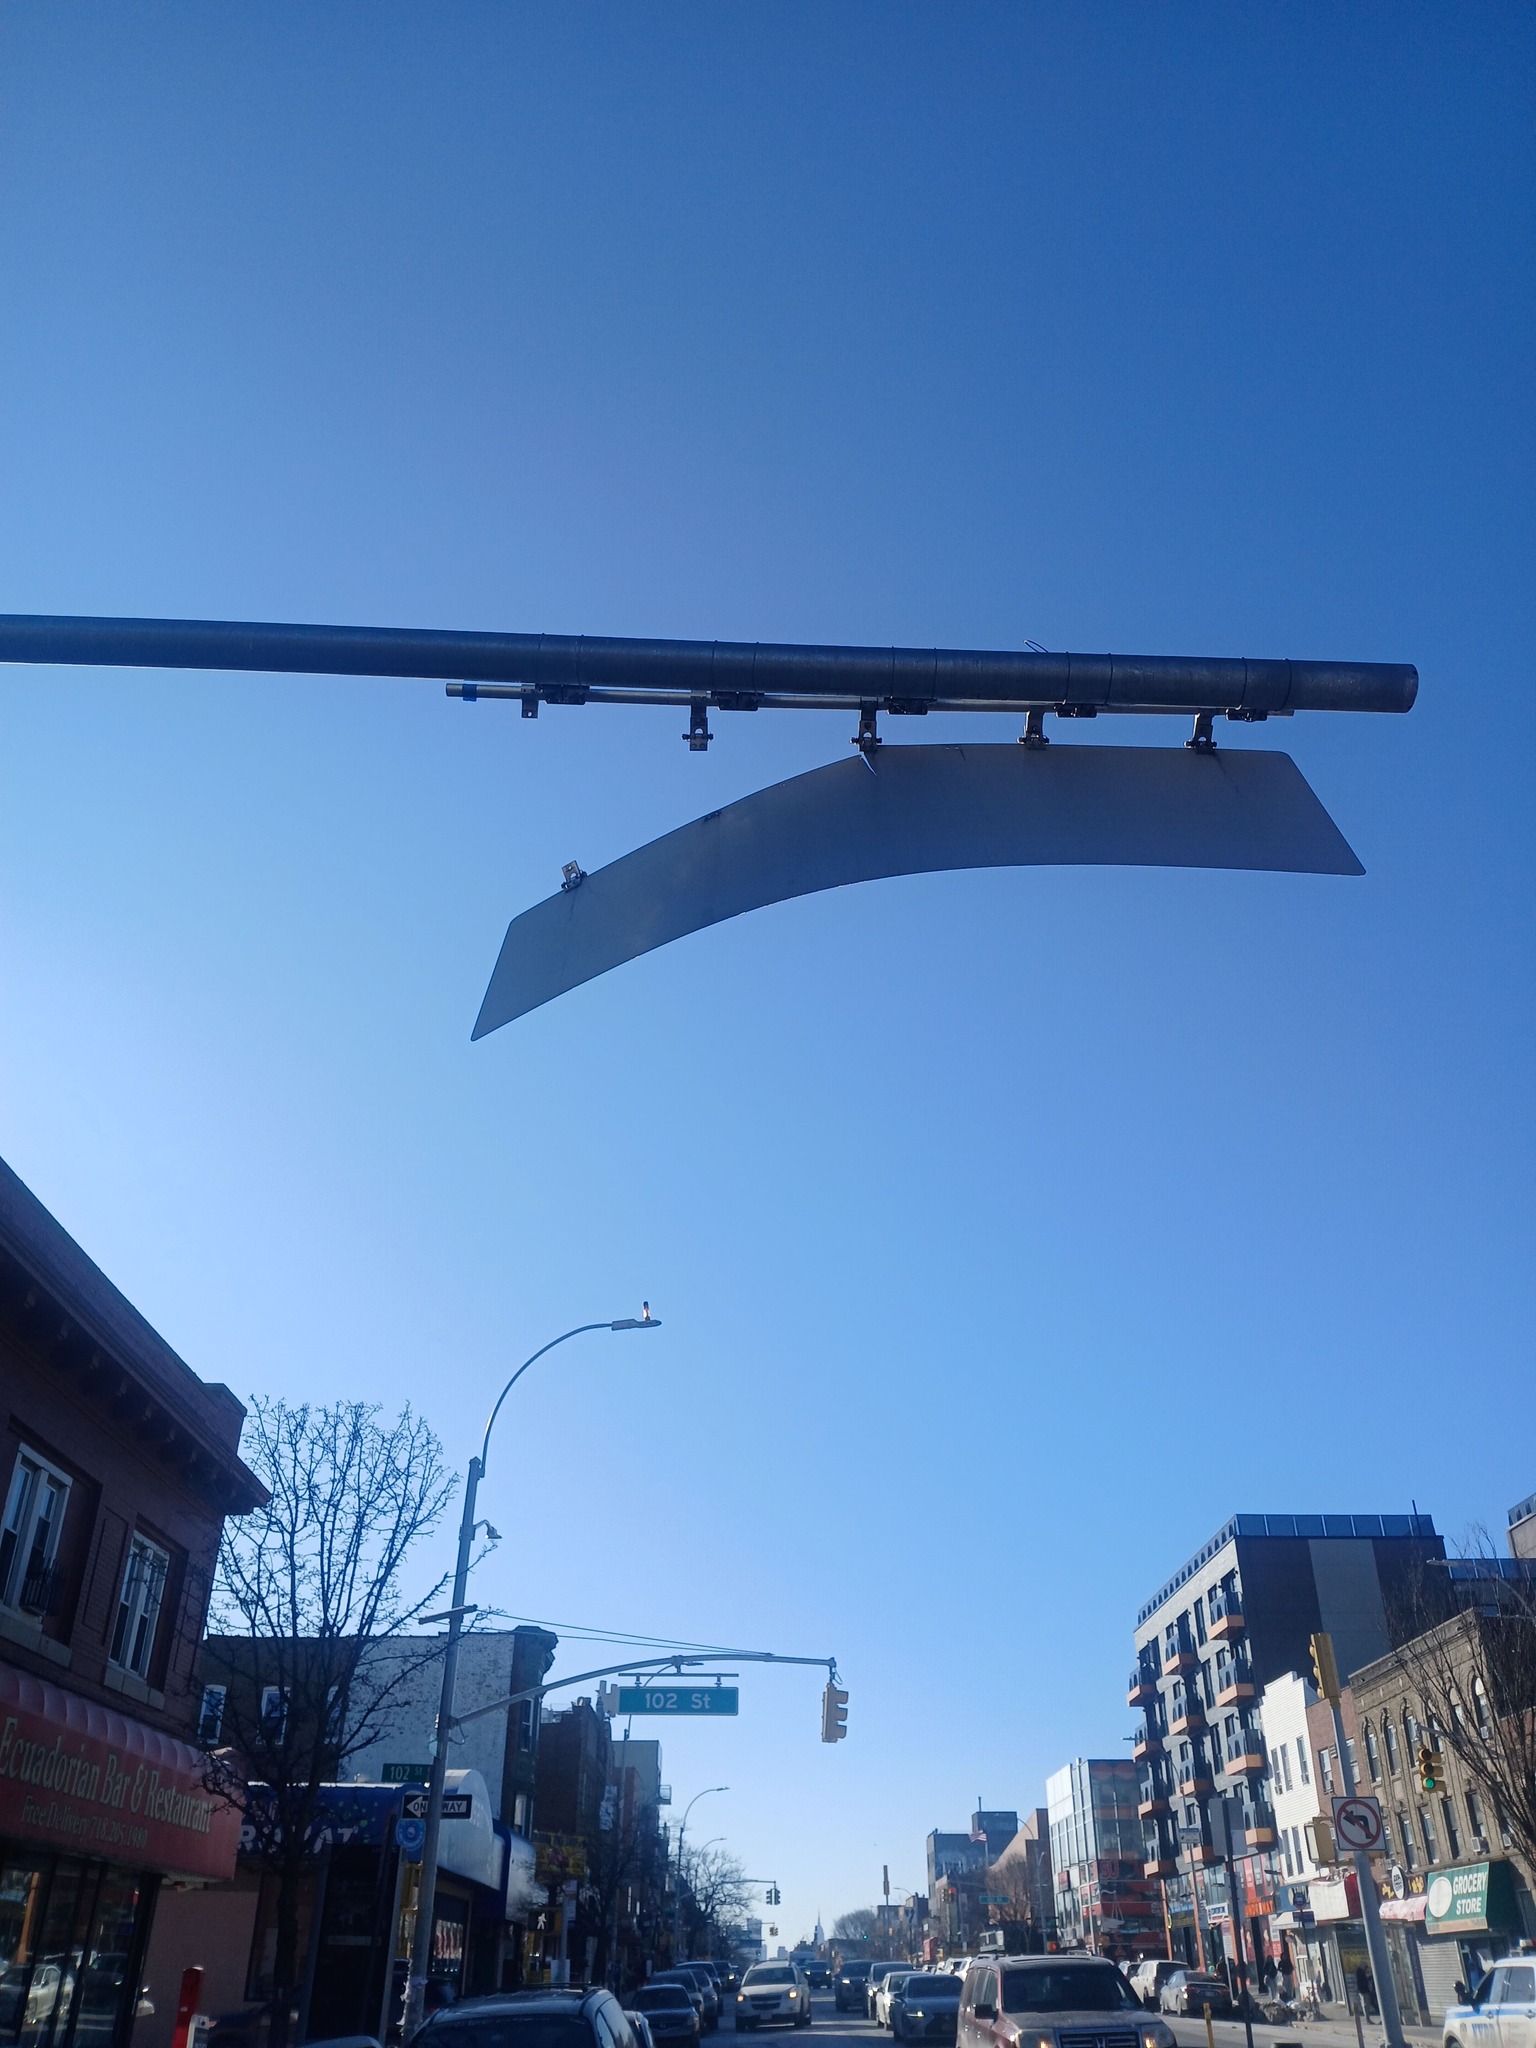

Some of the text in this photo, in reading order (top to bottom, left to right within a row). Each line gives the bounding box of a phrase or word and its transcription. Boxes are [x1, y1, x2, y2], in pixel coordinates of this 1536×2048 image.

[645, 1693, 711, 1709] 102 St
[0, 1716, 213, 1834] Ecuadorian Bar & Restaurant
[390, 1766, 410, 1780] 102
[21, 1795, 46, 1826] Free
[46, 1802, 90, 1841] Delivery
[1453, 1871, 1488, 1896] GROCERY
[1456, 1896, 1482, 1915] STORE
